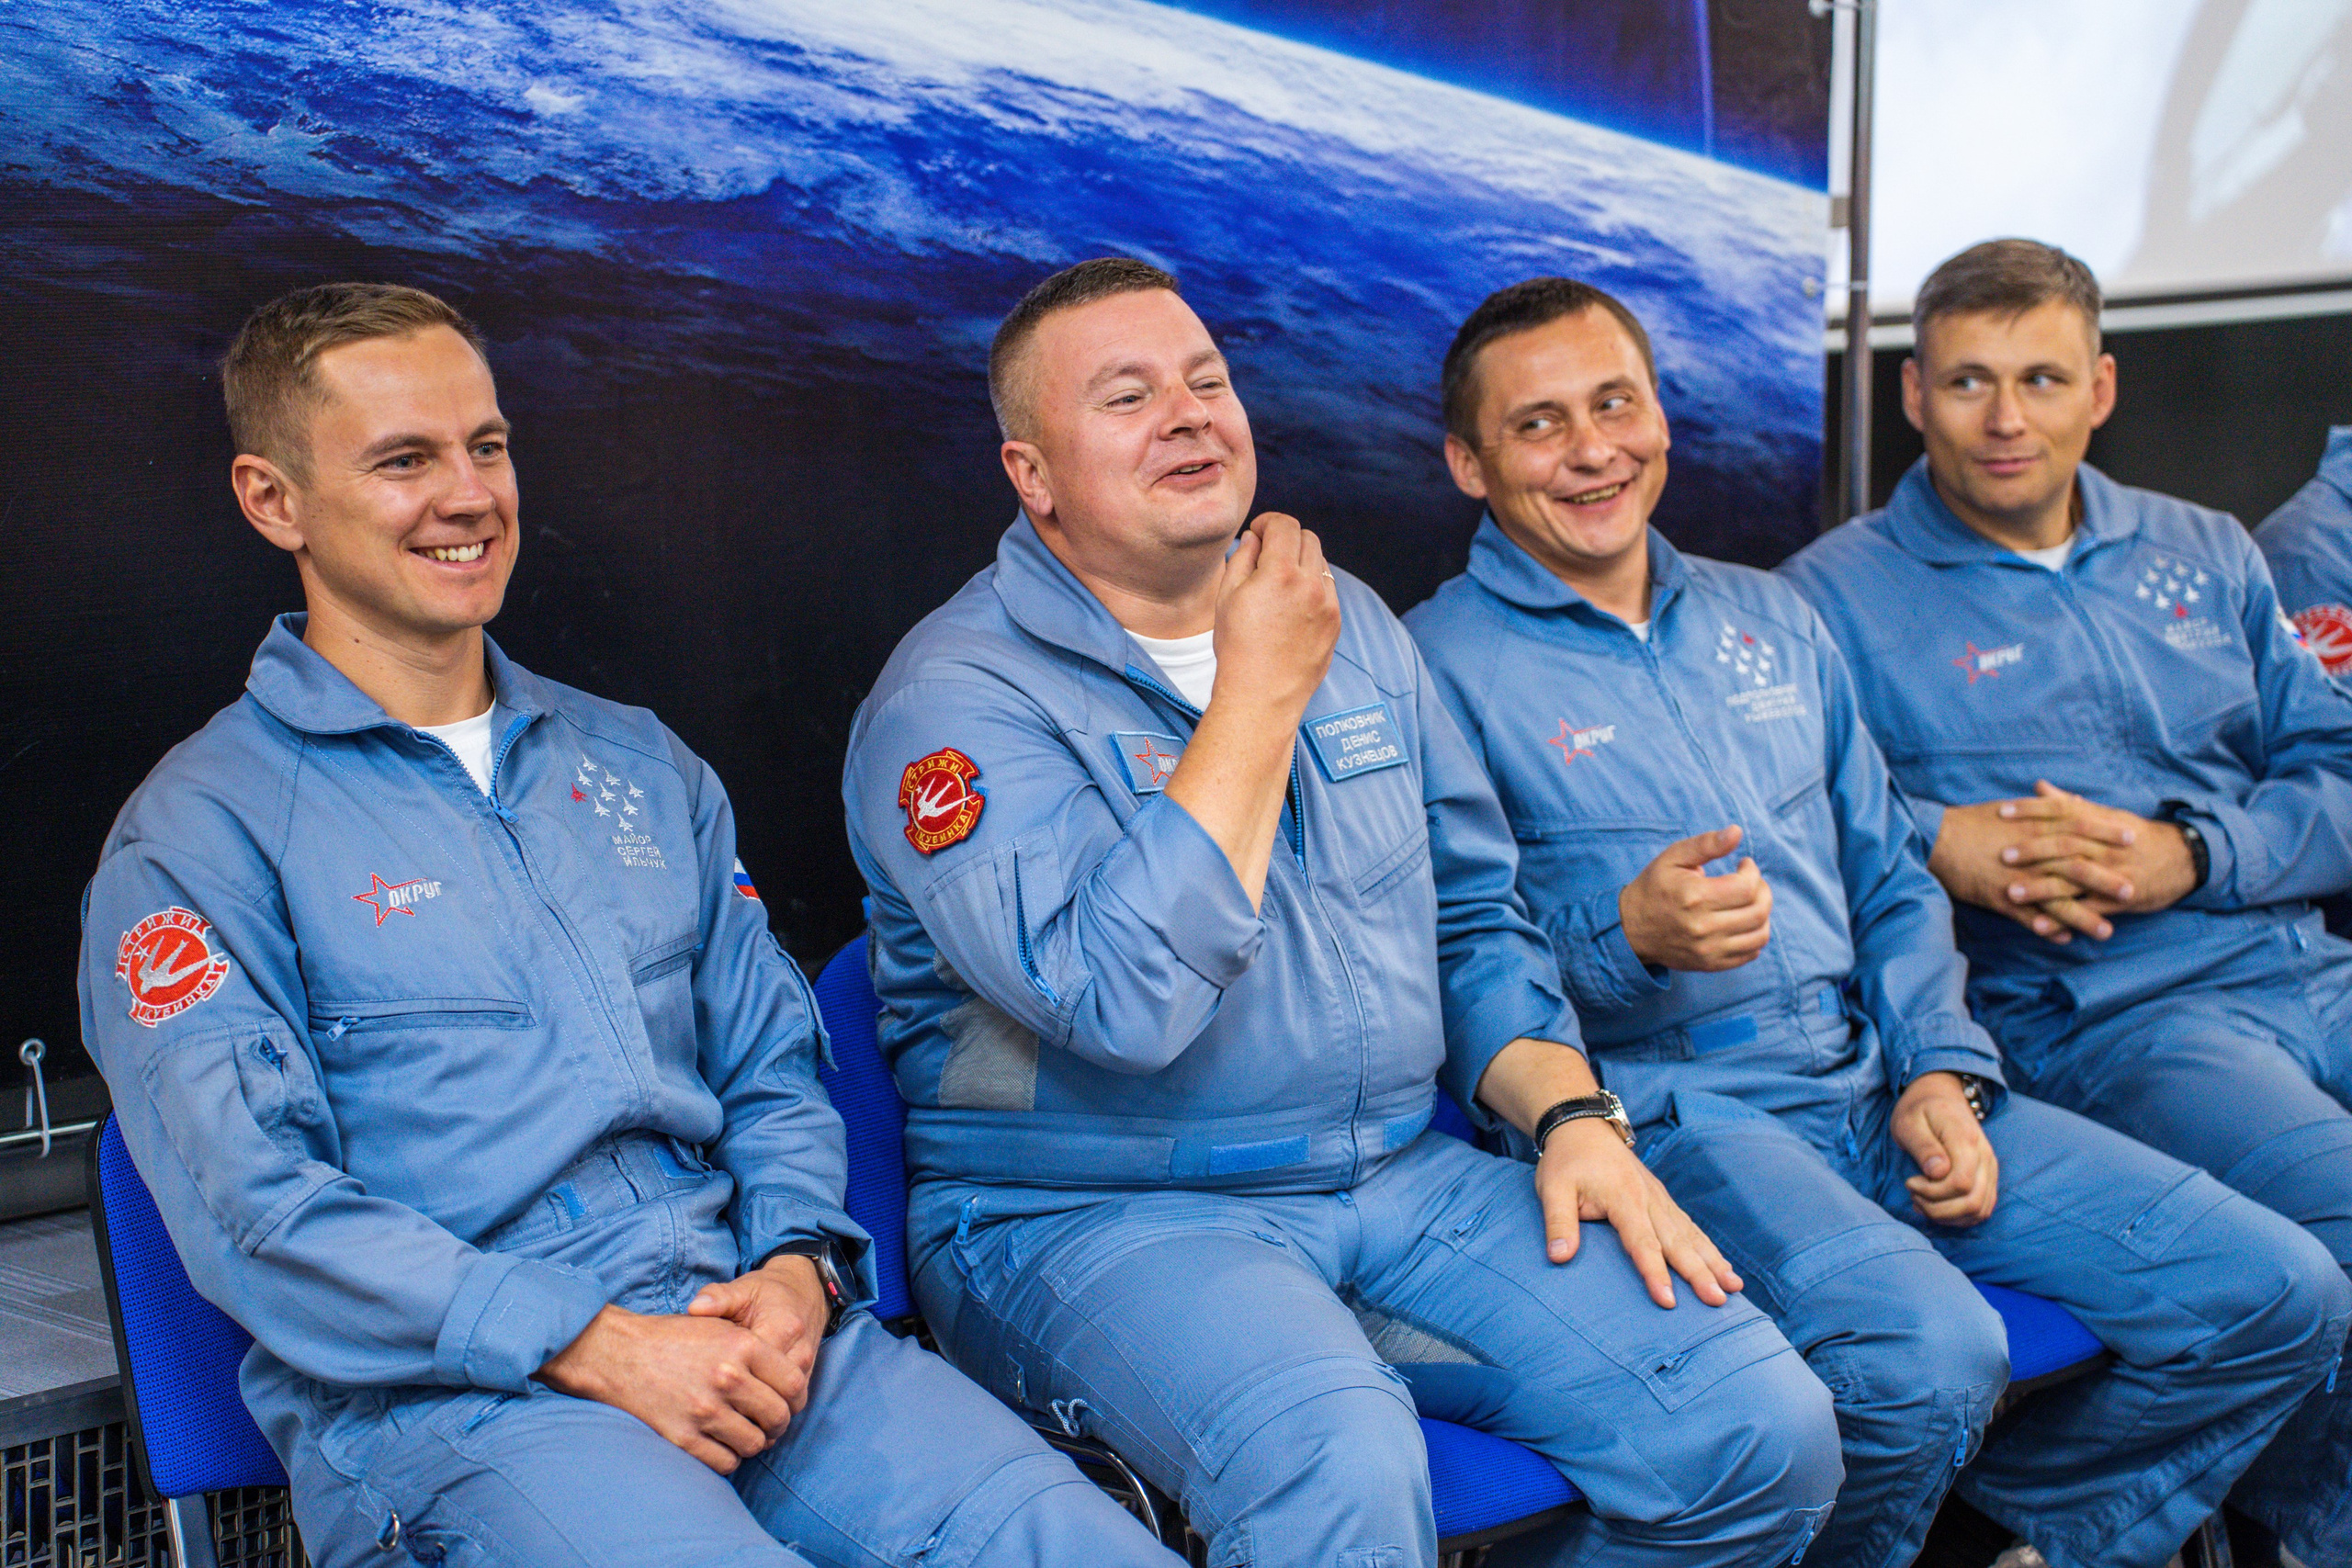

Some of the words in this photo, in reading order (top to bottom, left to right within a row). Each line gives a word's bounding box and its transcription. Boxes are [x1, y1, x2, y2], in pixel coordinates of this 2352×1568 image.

[1315, 710, 1386, 739] ПОЛКОВНИК
[1340, 730, 1381, 752] ДЕНИС
[1336, 745, 1398, 771] КУЗНЕЦОВ
[908, 759, 959, 789] СТРИЖИ
[612, 833, 651, 844] МАЙОР
[918, 815, 968, 842] КУБИНКА
[617, 845, 662, 859] СЕРГЕЙ
[389, 881, 442, 908] ОКРУГ
[122, 913, 192, 959] СТРИЖИ
[143, 979, 216, 1020] КУБИНКА
